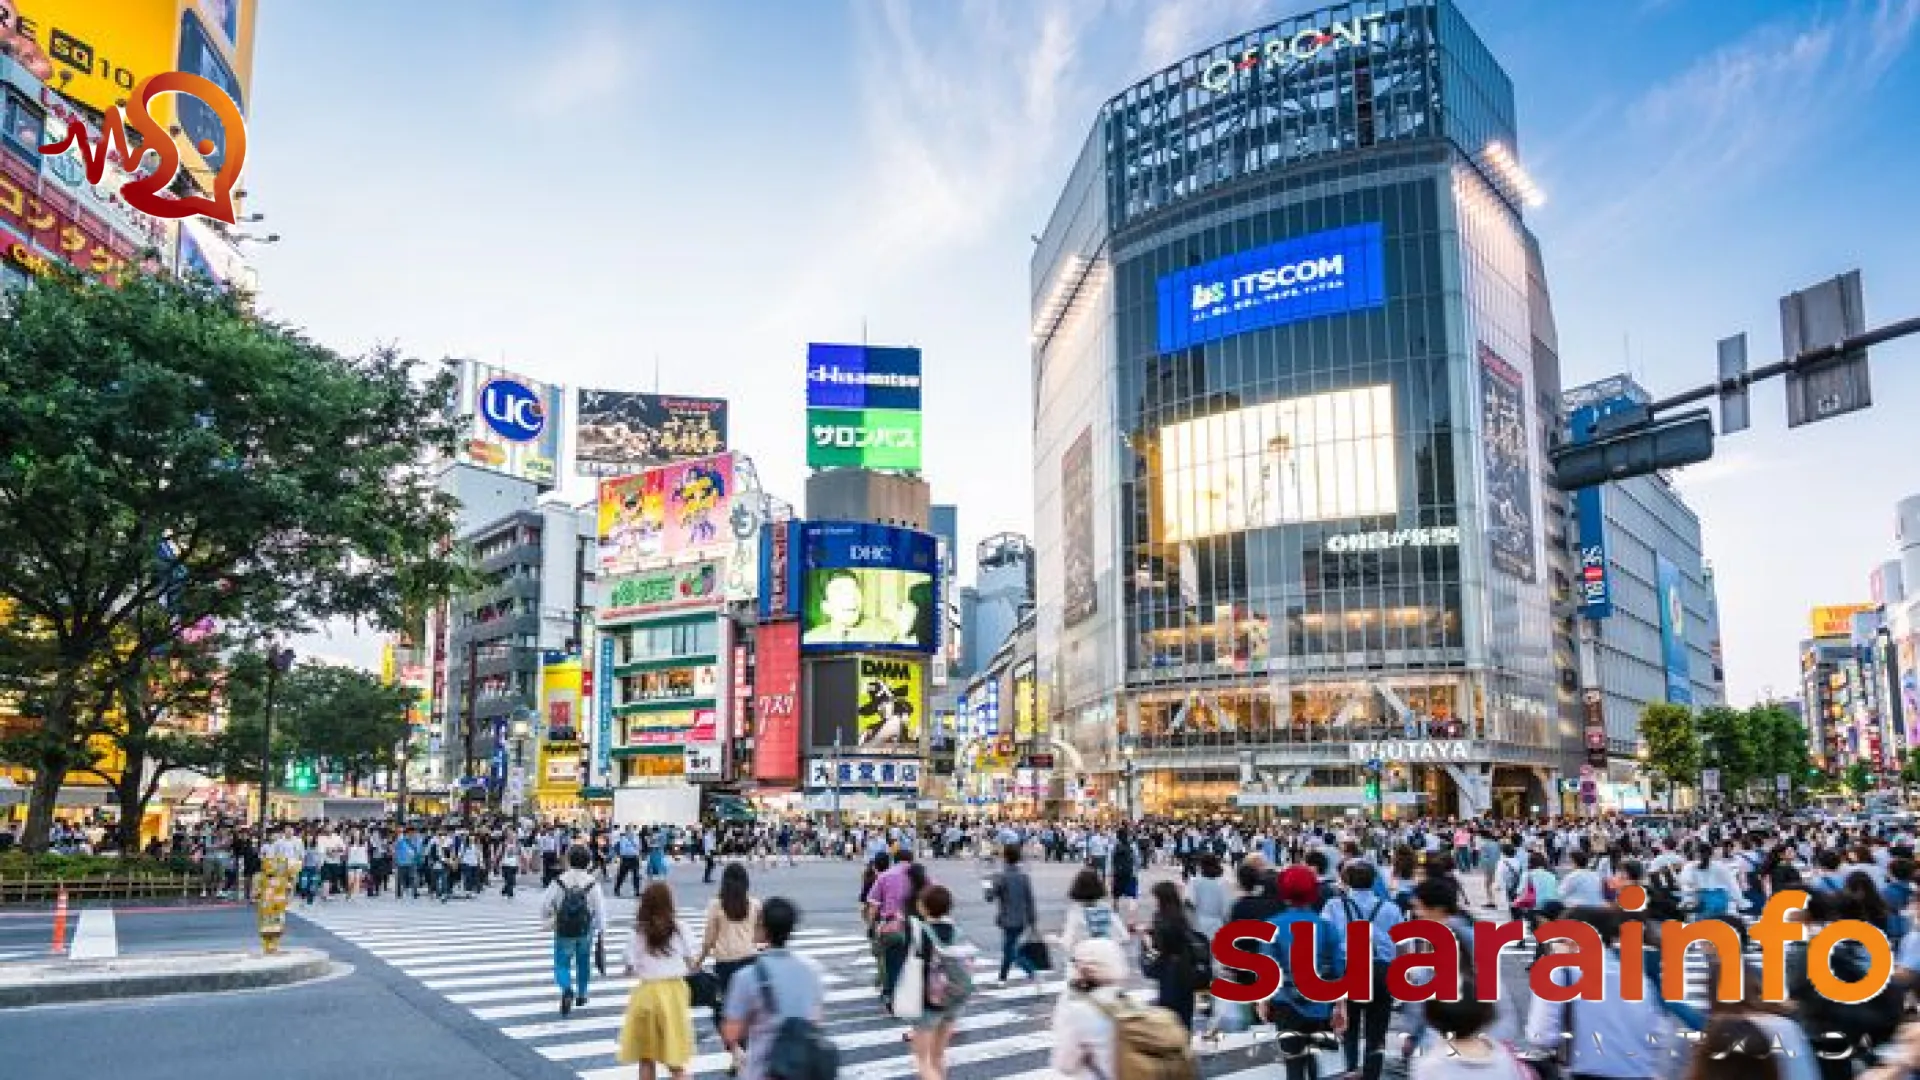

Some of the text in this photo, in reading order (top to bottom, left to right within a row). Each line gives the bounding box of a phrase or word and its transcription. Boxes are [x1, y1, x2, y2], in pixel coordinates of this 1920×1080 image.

[1202, 10, 1386, 95] QFRONT
[849, 544, 893, 563] DHC
[1350, 741, 1469, 760] TSUTAYA
